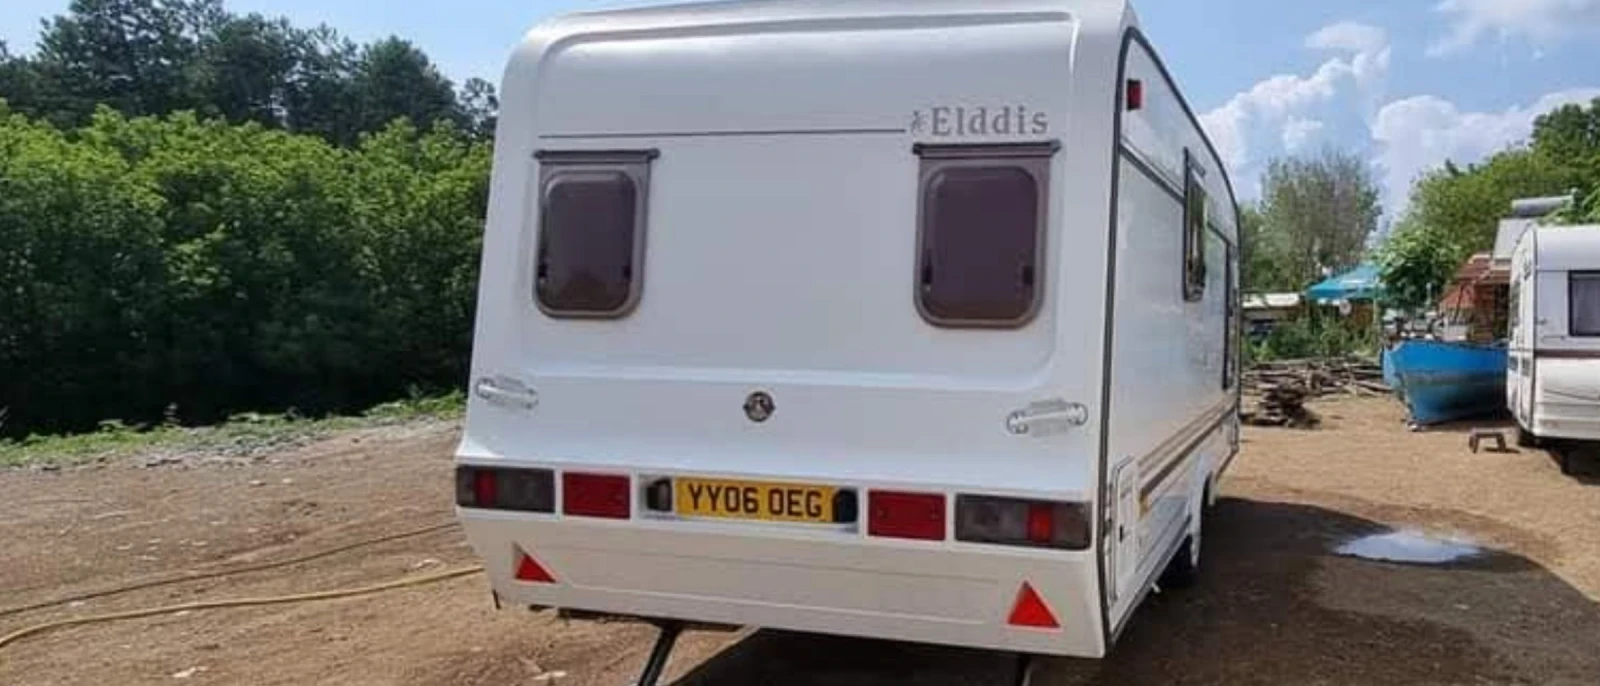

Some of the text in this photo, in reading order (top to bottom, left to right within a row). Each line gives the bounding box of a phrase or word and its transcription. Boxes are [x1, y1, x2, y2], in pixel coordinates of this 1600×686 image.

[931, 105, 1049, 135] Elddis
[688, 483, 822, 518] YY06 OEG
